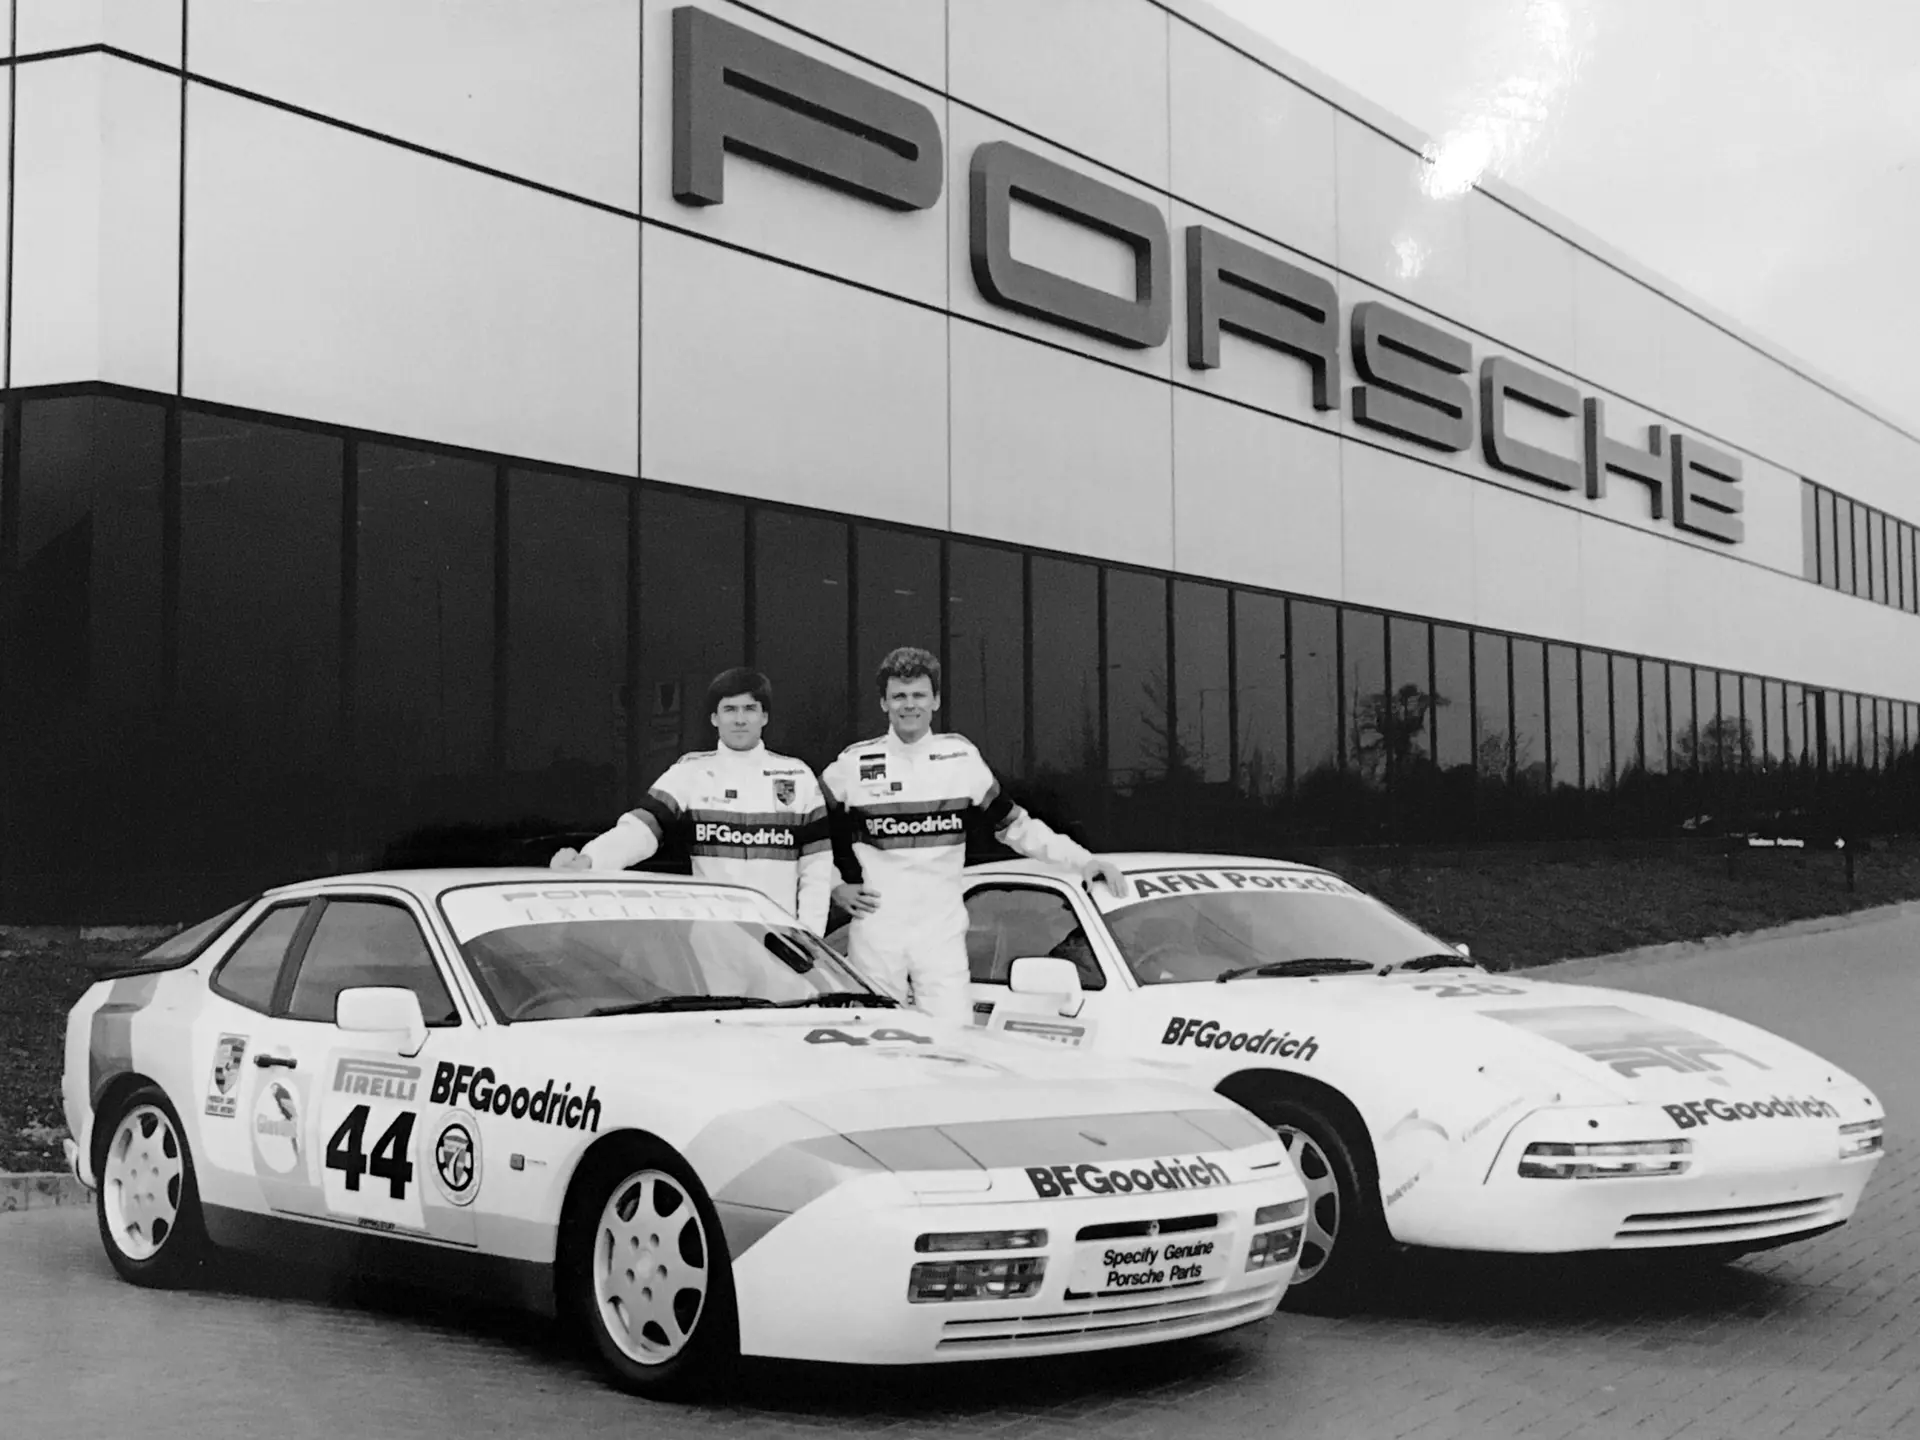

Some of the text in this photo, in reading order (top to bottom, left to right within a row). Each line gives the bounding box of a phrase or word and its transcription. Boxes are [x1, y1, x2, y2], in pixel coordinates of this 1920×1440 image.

[672, 5, 1744, 544] PORSCHE
[695, 823, 795, 846] BFGoodrich
[866, 813, 963, 836] BFGoodrich
[502, 889, 755, 903] PORSCHE
[1133, 872, 1219, 898] AFN
[803, 1028, 934, 1047] 44
[1161, 1016, 1319, 1062] BFGoodrich
[332, 1057, 422, 1102] PIRELLI
[430, 1060, 602, 1132] BFGoodrich
[1661, 1094, 1841, 1130] BFGoodrich
[325, 1104, 417, 1201] 44
[1025, 1155, 1232, 1199] BFGoodrich
[1103, 1240, 1215, 1269] Specify Genuine
[1106, 1262, 1203, 1288] Porsche Parts
